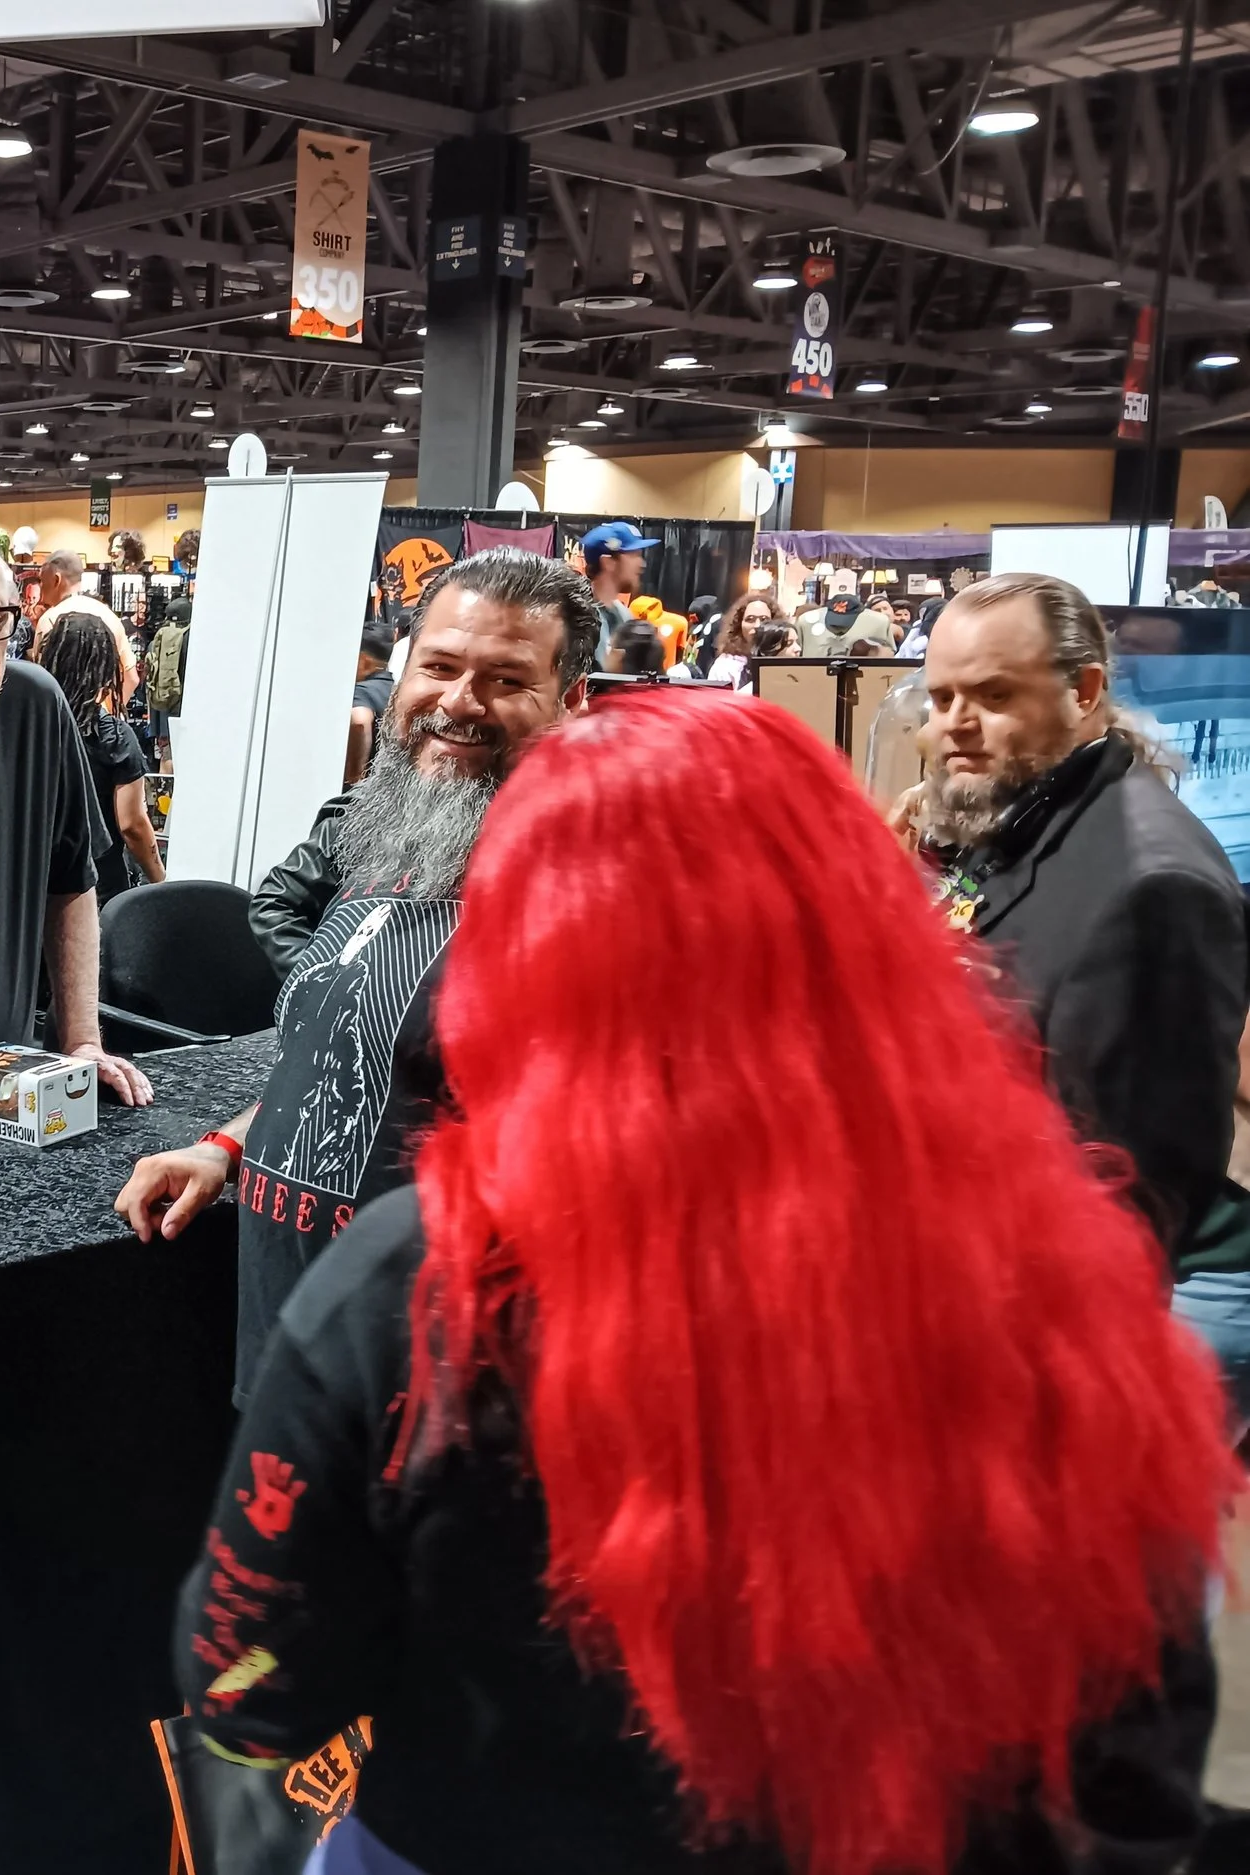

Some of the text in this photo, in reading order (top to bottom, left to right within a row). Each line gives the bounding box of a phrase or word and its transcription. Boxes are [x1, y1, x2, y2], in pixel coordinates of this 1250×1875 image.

[313, 231, 352, 251] SHIRT
[319, 247, 345, 260] COMPANY
[299, 264, 358, 313] 350
[792, 338, 833, 377] 450
[1124, 391, 1149, 422] 550
[91, 513, 109, 525] 790
[289, 1746, 349, 1806] TEE
